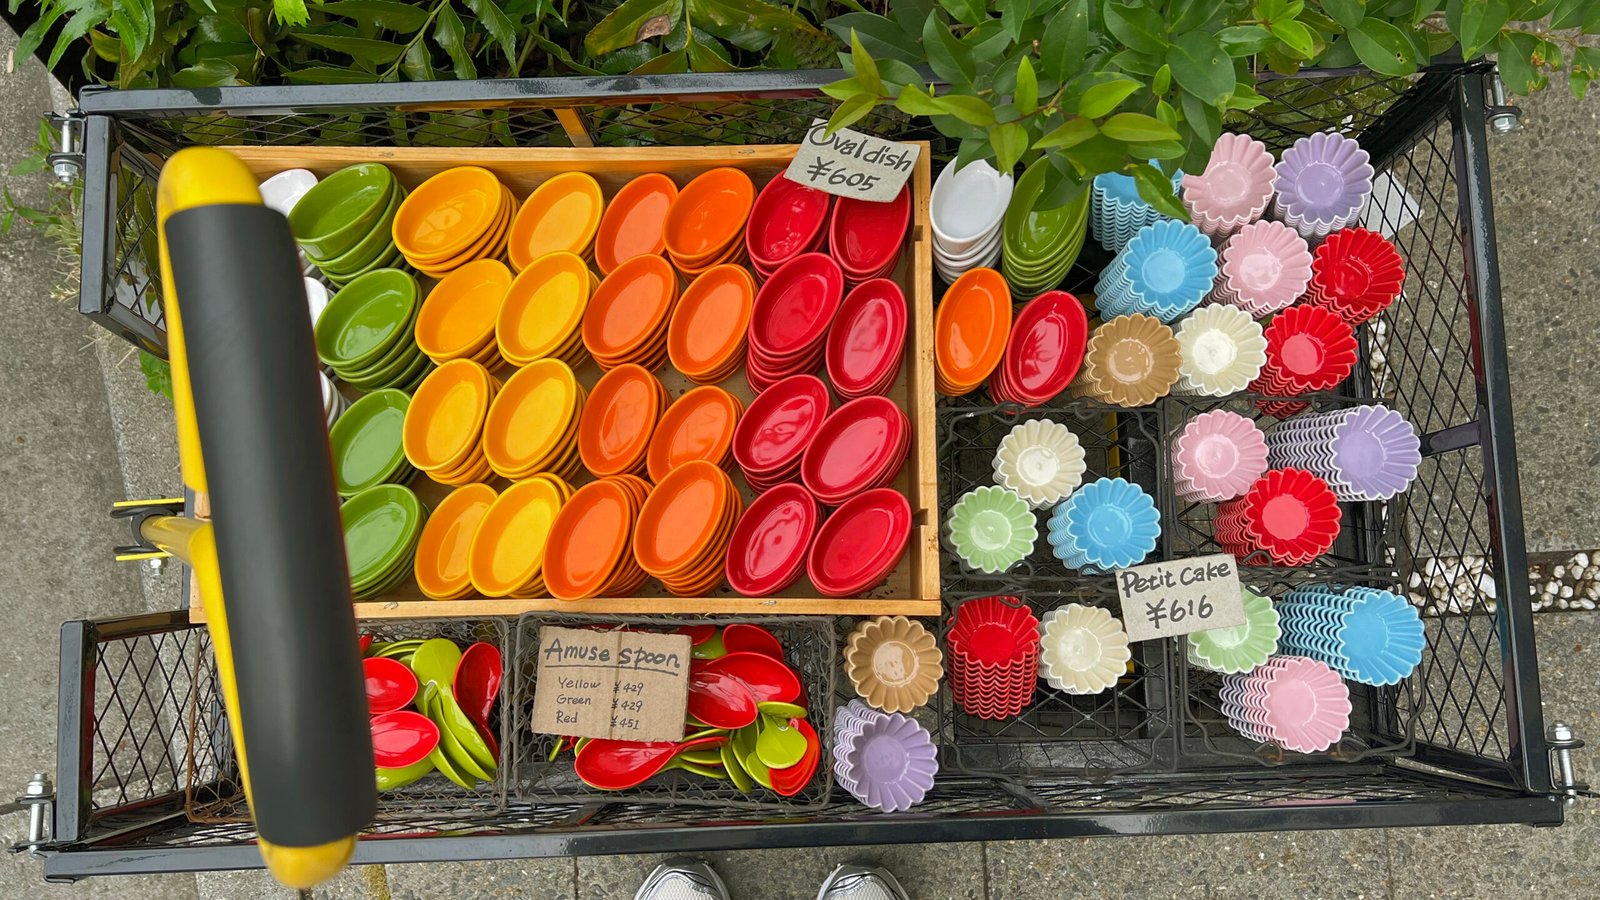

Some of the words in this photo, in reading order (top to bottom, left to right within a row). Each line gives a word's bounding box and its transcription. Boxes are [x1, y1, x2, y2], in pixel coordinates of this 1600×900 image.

[809, 125, 868, 158] Oval
[862, 145, 912, 172] dish
[807, 156, 881, 191] ¥605
[1119, 567, 1176, 598] Petit
[1179, 562, 1231, 586] Cake
[1145, 594, 1213, 629] ¥616
[544, 637, 611, 662] Amuse
[558, 676, 601, 690] Yellow
[556, 693, 592, 706] Green
[556, 710, 578, 724] Red
